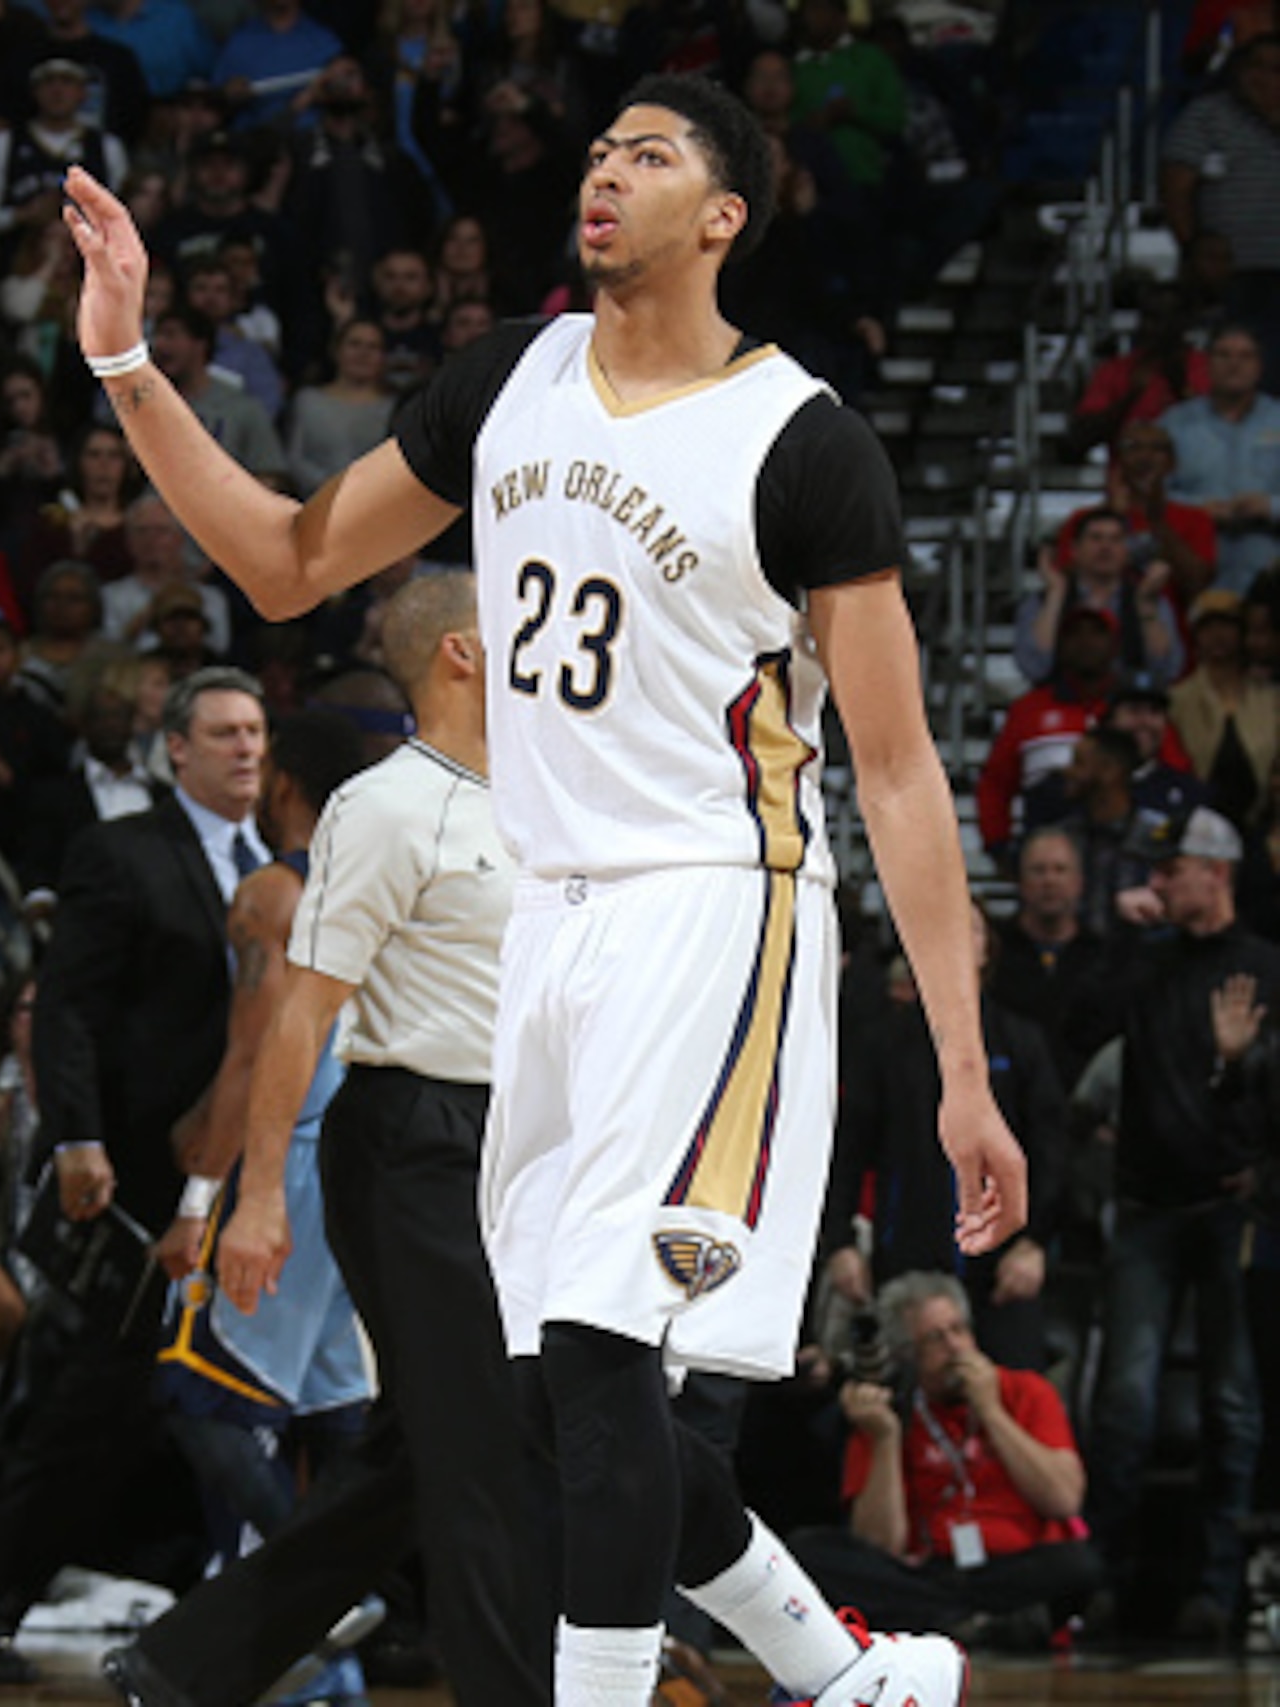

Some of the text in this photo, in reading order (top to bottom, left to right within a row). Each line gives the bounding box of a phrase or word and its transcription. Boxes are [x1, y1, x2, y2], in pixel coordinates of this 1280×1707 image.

[491, 461, 700, 584] NEW ORLEANS
[509, 556, 624, 715] 23
